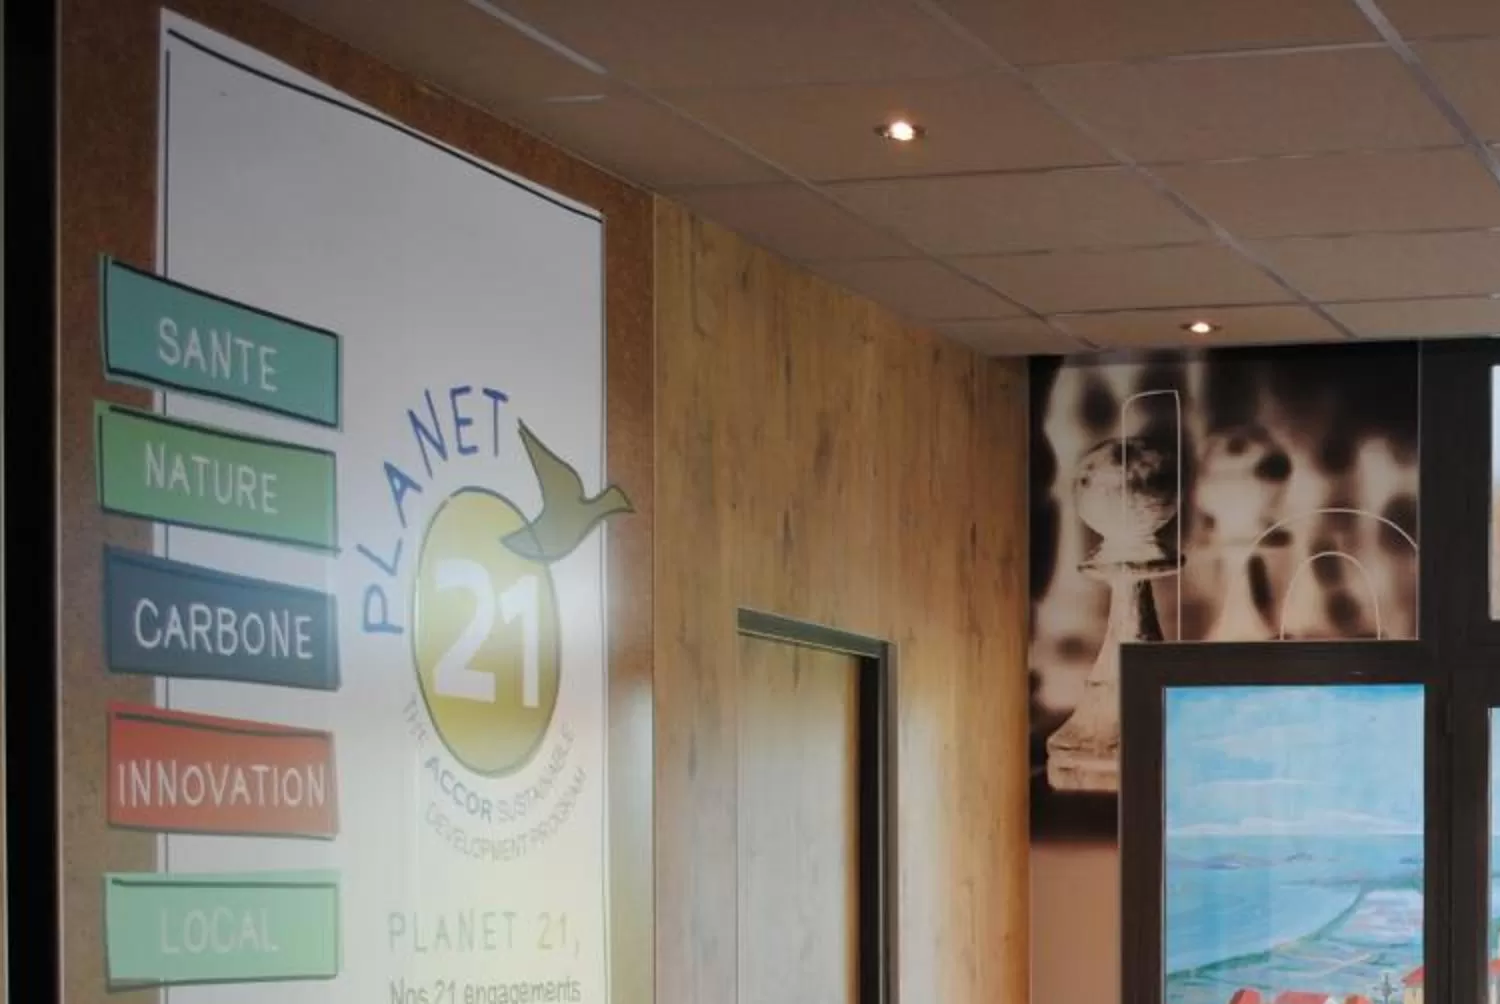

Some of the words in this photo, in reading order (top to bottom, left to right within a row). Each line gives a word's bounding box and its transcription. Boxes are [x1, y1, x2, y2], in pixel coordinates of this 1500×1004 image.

[158, 316, 278, 392] SANTE
[144, 440, 279, 514] NATURE
[357, 386, 508, 635] PLANET
[134, 598, 314, 660] CARBONE
[433, 559, 540, 708] 21
[117, 762, 325, 808] INNOVATION
[425, 756, 492, 823] ACCOR
[161, 907, 280, 955] LOCAL
[387, 908, 516, 952] PLANET
